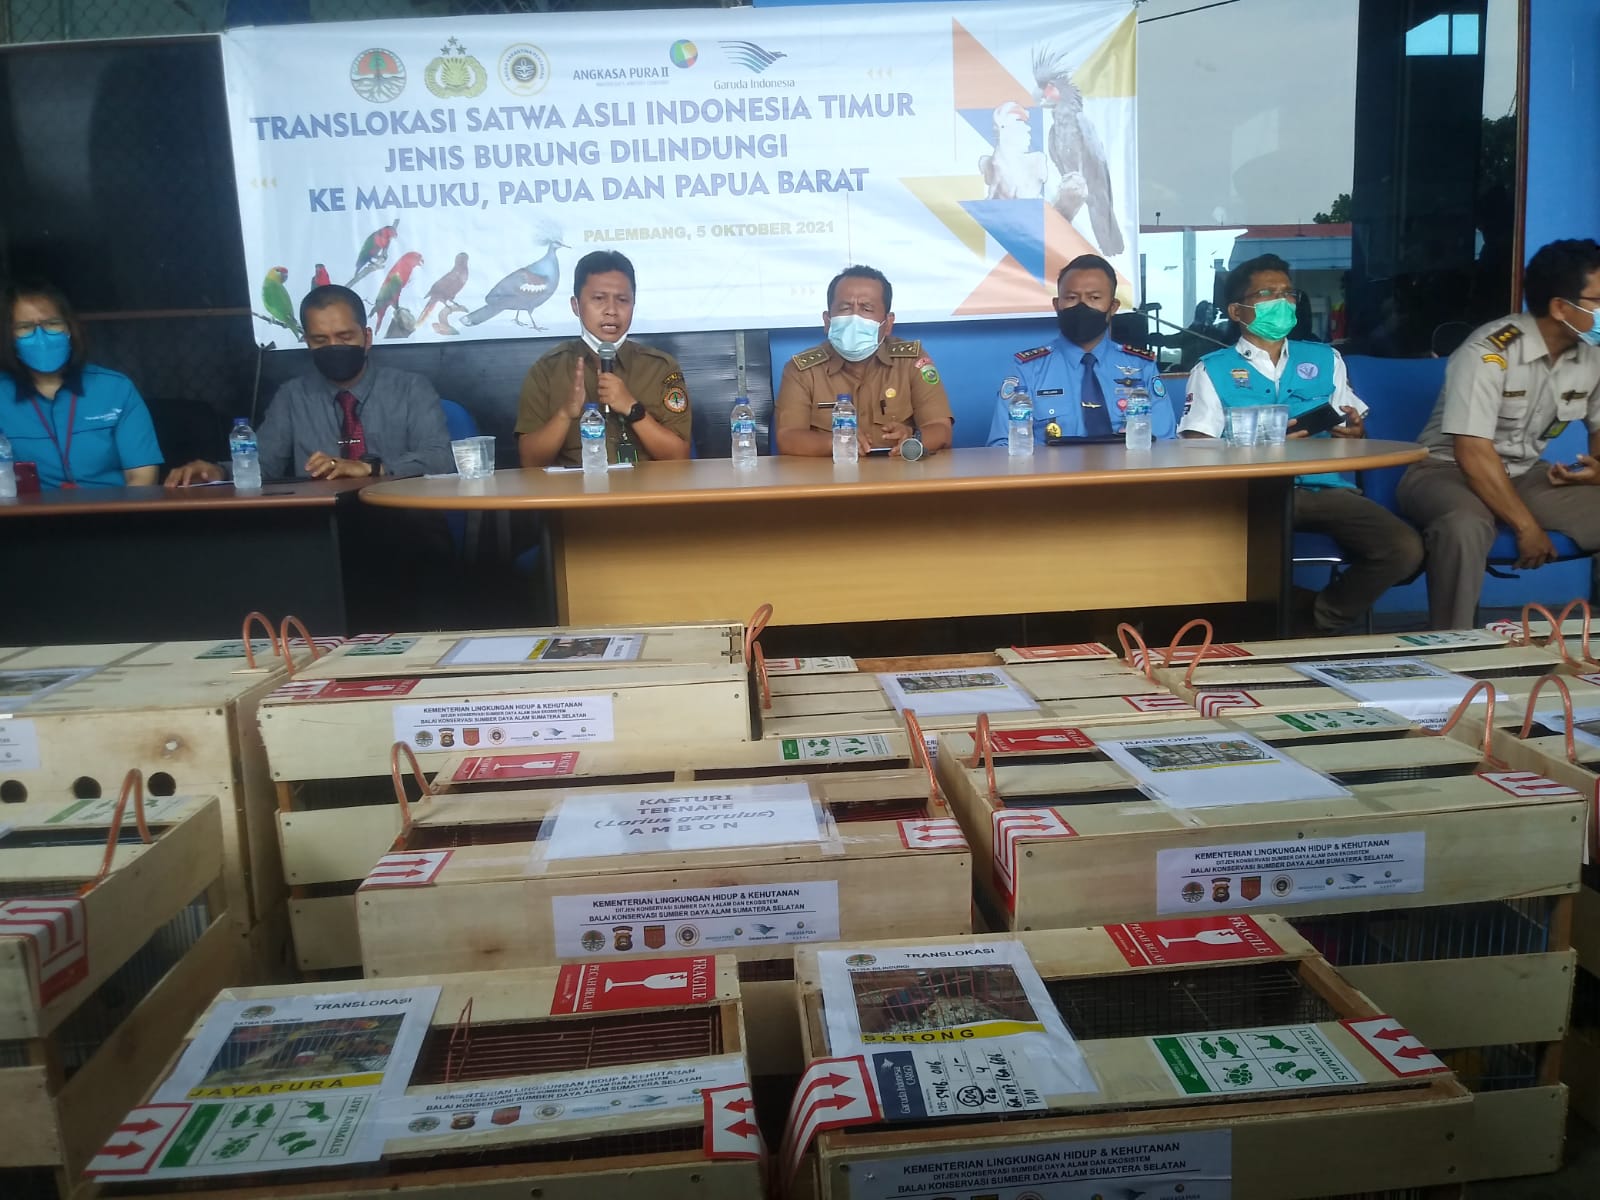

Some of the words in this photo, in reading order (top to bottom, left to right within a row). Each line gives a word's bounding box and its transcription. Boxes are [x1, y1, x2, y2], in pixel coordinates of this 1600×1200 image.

[573, 68, 627, 80] ANGKASA
[629, 67, 660, 79] PURA
[661, 66, 669, 77] II
[713, 79, 748, 90] Garuda
[750, 78, 795, 89] Indonesia
[249, 108, 457, 141] TRANSLOKASI
[466, 105, 566, 132] SATWA
[572, 101, 636, 128] ASLI
[646, 95, 813, 125] INDONESIA
[818, 92, 916, 119] TIMUR
[384, 145, 465, 173] JENIS
[474, 140, 600, 169] BURUNG
[610, 133, 788, 164] DILINDUNGI
[308, 187, 346, 213] KE
[355, 182, 489, 210] MALUKU,
[498, 177, 595, 205] PAPUA
[601, 175, 665, 201] DAN
[675, 171, 770, 198] PAPUA
[778, 167, 870, 194] BARAT
[583, 226, 692, 242] PALEMBANG,
[696, 225, 706, 238] 5
[710, 222, 792, 237] OKTOBER
[796, 220, 834, 234] 2021
[637, 804, 733, 815] TERNATE
[640, 795, 733, 806] KASTURI
[594, 817, 672, 829] (Lorius
[676, 810, 775, 824] garrulus)
[1195, 849, 1252, 860] KEMENTERIAN
[1254, 846, 1306, 855] LINGKUNGAN
[1342, 840, 1390, 849] KEHUTANAN
[1212, 864, 1255, 872] KONSERVASI
[1257, 861, 1285, 869] SUMBER
[1326, 856, 1362, 864] SUMATERA
[593, 898, 653, 908] KEMENTERIAN
[655, 894, 710, 904] LINGKUNGAN
[712, 893, 738, 901] HIDUP
[748, 889, 800, 899] KEHUTANAN
[612, 912, 657, 920] KONSERVASI
[659, 910, 688, 918] SUMBER
[1129, 923, 1151, 945] PECAH
[1229, 915, 1274, 954] FRAGILE
[904, 948, 996, 958] TRANSLOKASI
[586, 965, 600, 985] PECAH
[692, 958, 707, 1000] FRAGILE
[314, 997, 413, 1011] TRANSLOKASI
[582, 985, 596, 1010] BELAH
[863, 1029, 976, 1042] SORONG
[1299, 1029, 1314, 1048] LIVE
[1313, 1047, 1350, 1082] ANIMALS
[190, 1079, 344, 1097] JAYAPURA
[426, 1102, 454, 1110] BALAI
[456, 1096, 514, 1107] KONSERVASI
[517, 1092, 554, 1101] SUMBER
[583, 1086, 608, 1094] ALAM
[611, 1081, 659, 1091] SUMATERA
[661, 1076, 701, 1085] SELATAN
[435, 1087, 512, 1100] KEMENTERIAN
[514, 1080, 584, 1092] LINGKUNGAN
[587, 1076, 619, 1085] HIDUP
[631, 1068, 695, 1080] KEHUTANAN
[348, 1096, 364, 1114] LIVE
[329, 1115, 355, 1154] ANIMALS
[903, 1159, 984, 1175] KEMENTERIAN
[987, 1153, 1060, 1167] LINGKUNGAN
[1063, 1150, 1097, 1161] HIDUP
[1100, 1149, 1107, 1157] &
[1111, 1143, 1180, 1156] KEHUTANAN
[933, 1172, 959, 1181] DITJEN
[961, 1168, 1009, 1178] KONSERVASI
[1011, 1165, 1043, 1174] SUMBER
[1044, 1163, 1065, 1171] DAYA
[1068, 1161, 1088, 1169] ALAM
[1090, 1159, 1106, 1167] DAN
[1108, 1155, 1150, 1166] EKOSISTEM
[898, 1183, 926, 1193] BALAI
[928, 1178, 989, 1191] KONSERVASI
[992, 1174, 1030, 1185] SUMBER
[1033, 1172, 1059, 1181] DAYA
[1060, 1169, 1087, 1179] ALAM
[1090, 1165, 1140, 1176] SUMATERA
[1144, 1161, 1186, 1172] SELATAN
